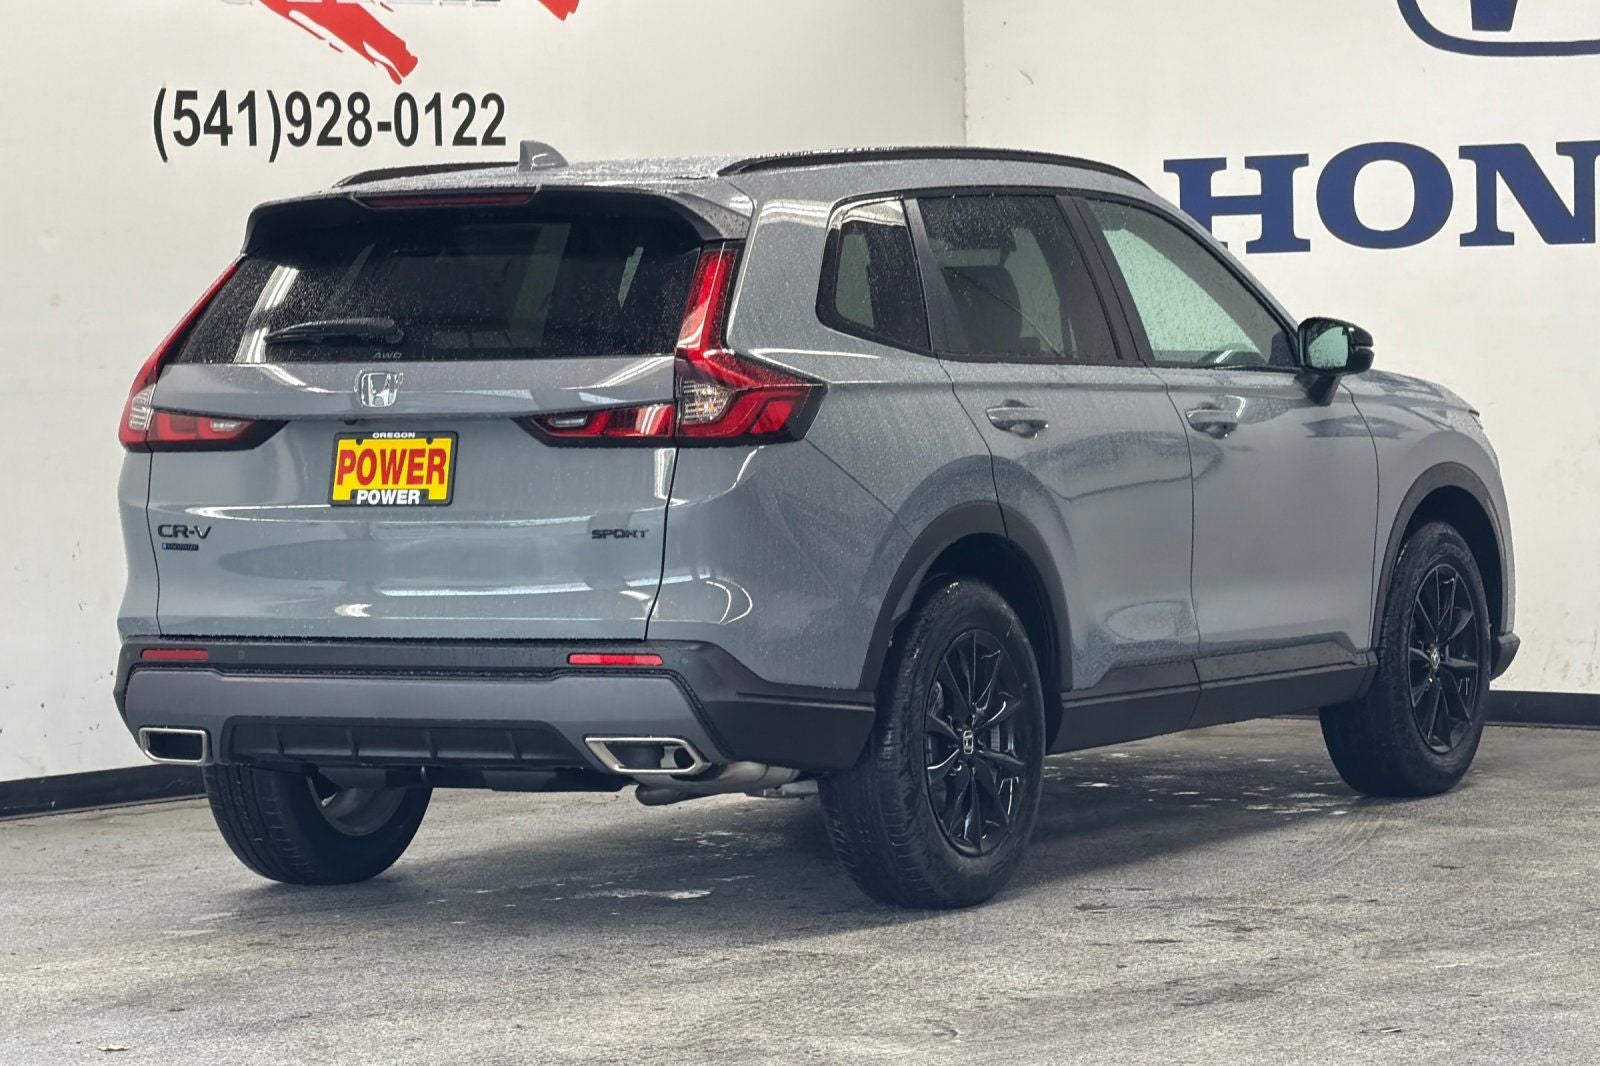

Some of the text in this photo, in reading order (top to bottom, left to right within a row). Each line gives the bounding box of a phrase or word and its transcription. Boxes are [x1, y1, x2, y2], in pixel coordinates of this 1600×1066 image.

[152, 86, 507, 164] (541)928-0122
[1163, 140, 1600, 254] HON
[336, 448, 447, 486] POWER
[356, 489, 421, 505] POWER
[157, 524, 212, 539] CR-V
[591, 529, 649, 539] SPORT
